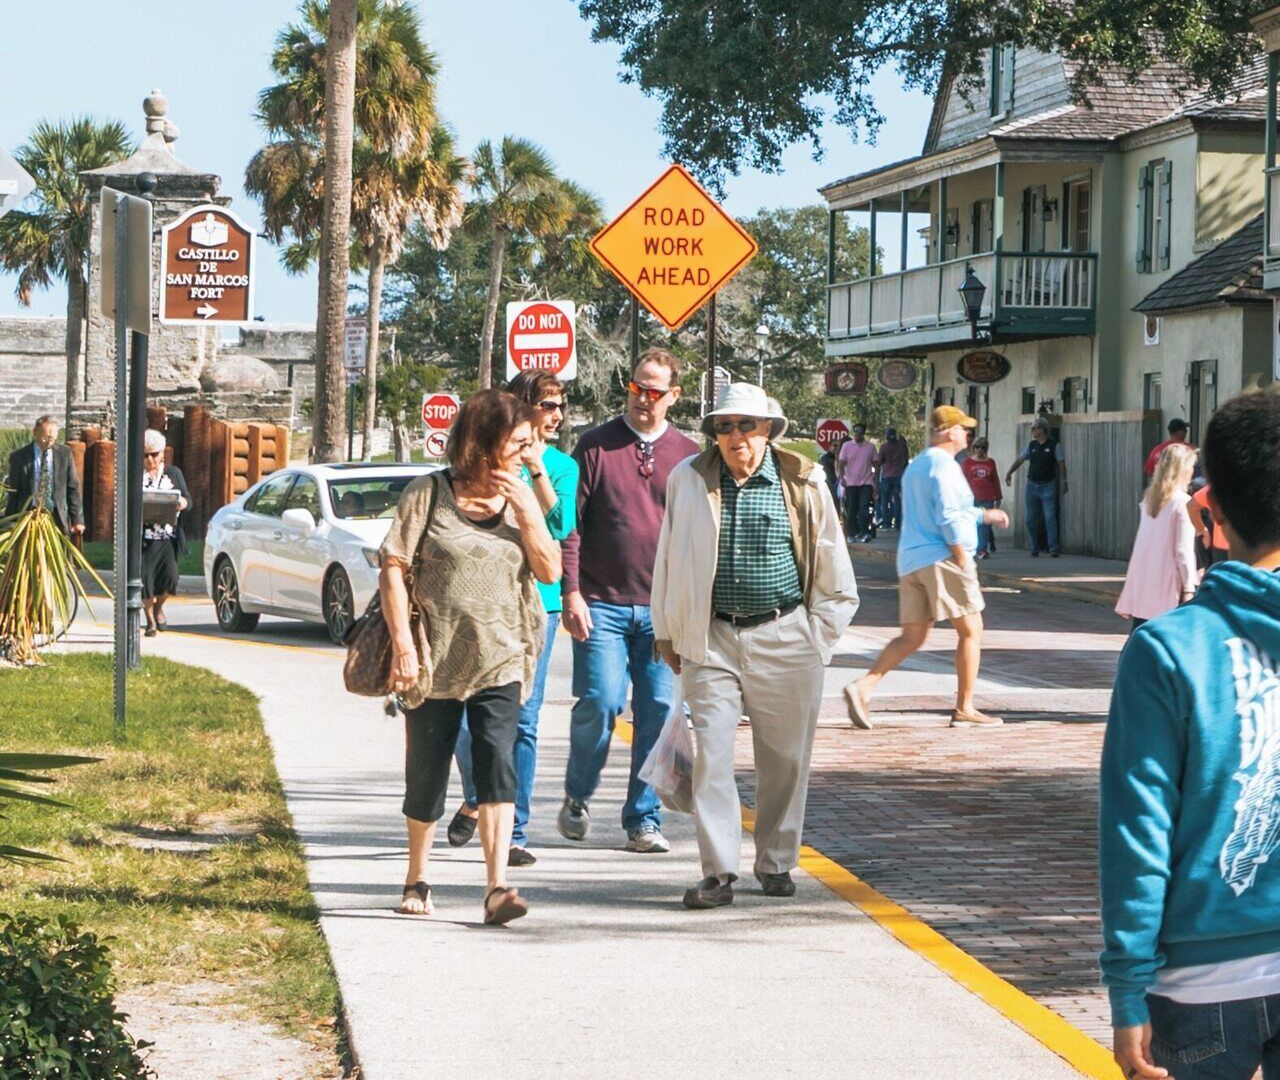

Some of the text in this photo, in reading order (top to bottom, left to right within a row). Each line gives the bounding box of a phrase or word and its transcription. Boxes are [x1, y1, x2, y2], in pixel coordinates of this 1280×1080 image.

[644, 207, 705, 226] ROAD
[644, 237, 704, 256] WORK
[178, 248, 240, 261] CASTILLO
[199, 261, 218, 272] DE
[166, 273, 249, 286] SAN MARCOS
[636, 267, 711, 286] AHEAD
[190, 287, 225, 299] FORT
[518, 313, 563, 331] DO NOT
[520, 353, 561, 369] ENTER
[424, 404, 457, 419] STOP
[819, 429, 848, 442] STOP
